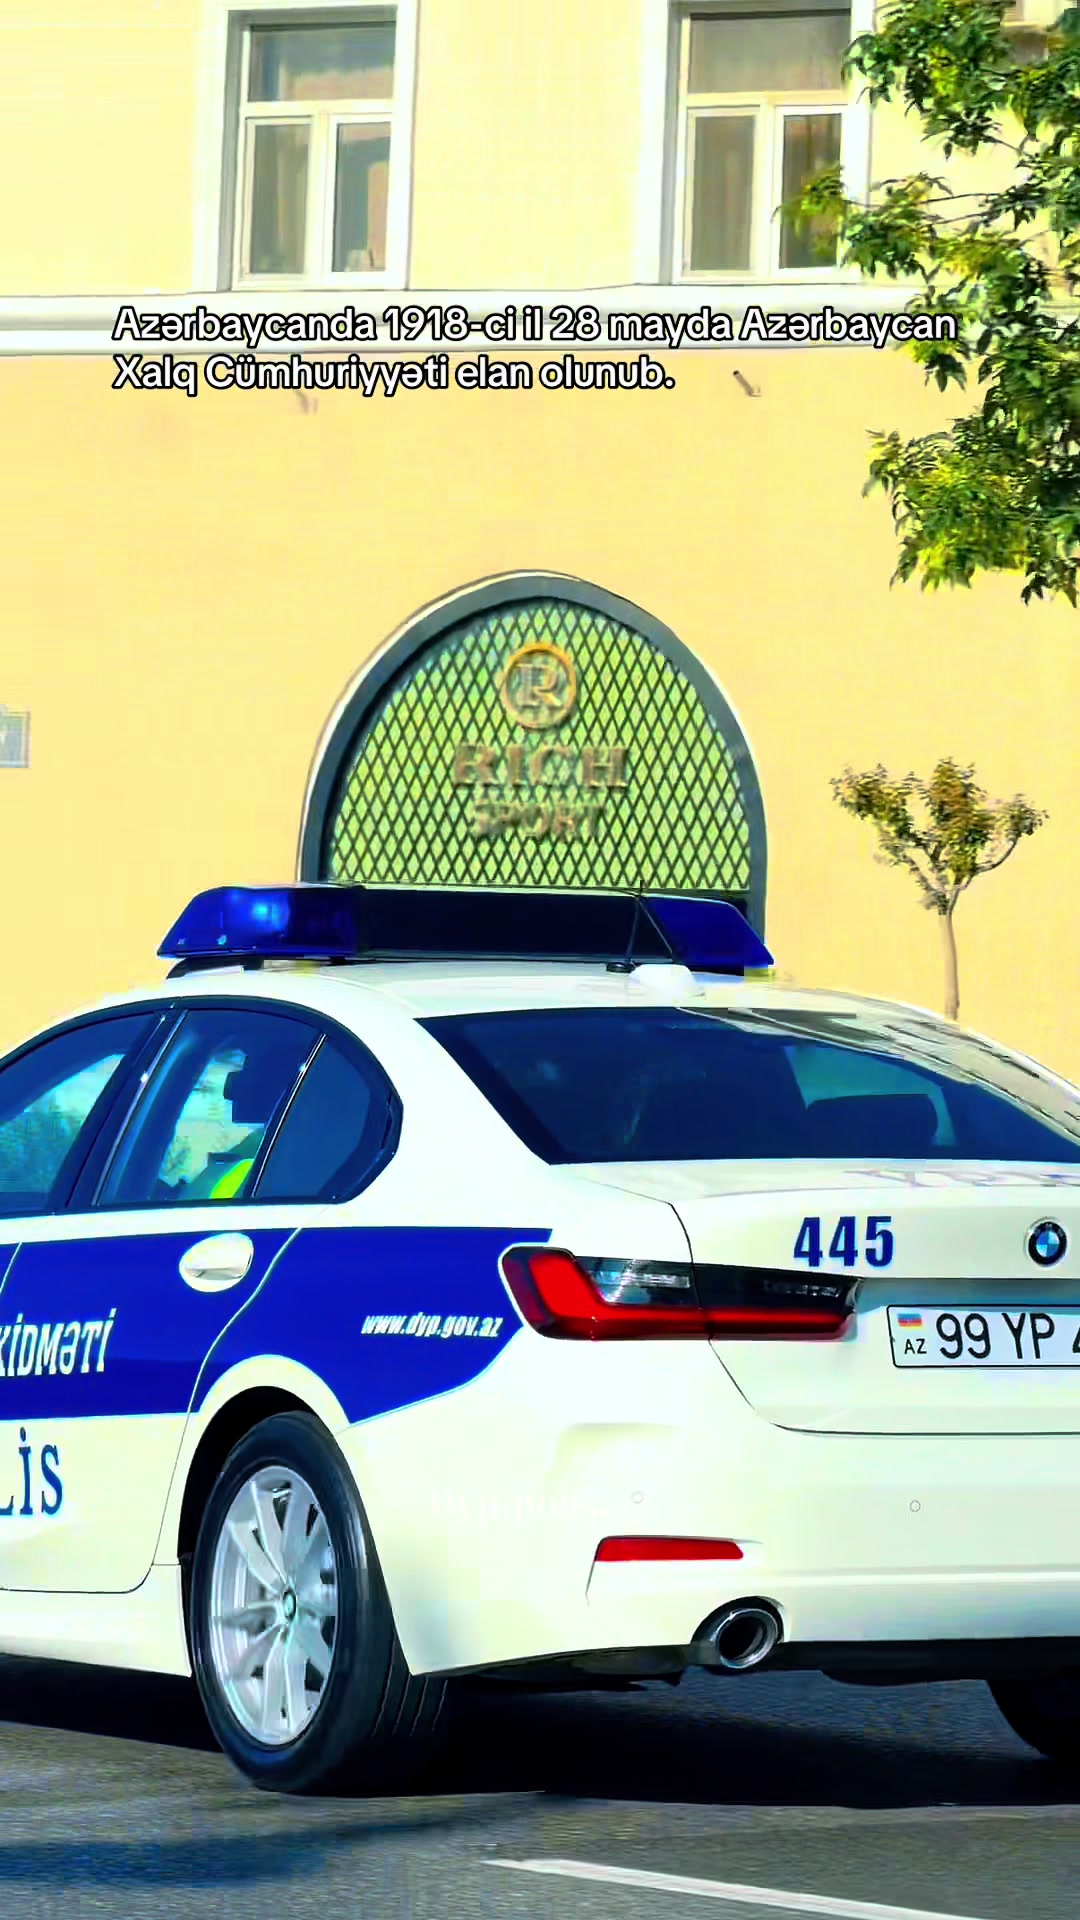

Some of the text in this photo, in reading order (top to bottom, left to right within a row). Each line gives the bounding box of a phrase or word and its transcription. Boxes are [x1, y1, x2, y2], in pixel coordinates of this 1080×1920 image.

[453, 744, 628, 788] RICH
[793, 1216, 895, 1268] 445
[360, 1311, 504, 1339] www.dyp.gov.az
[904, 1338, 927, 1355] AZ
[936, 1312, 991, 1359] 99
[1002, 1312, 1055, 1359] YP
